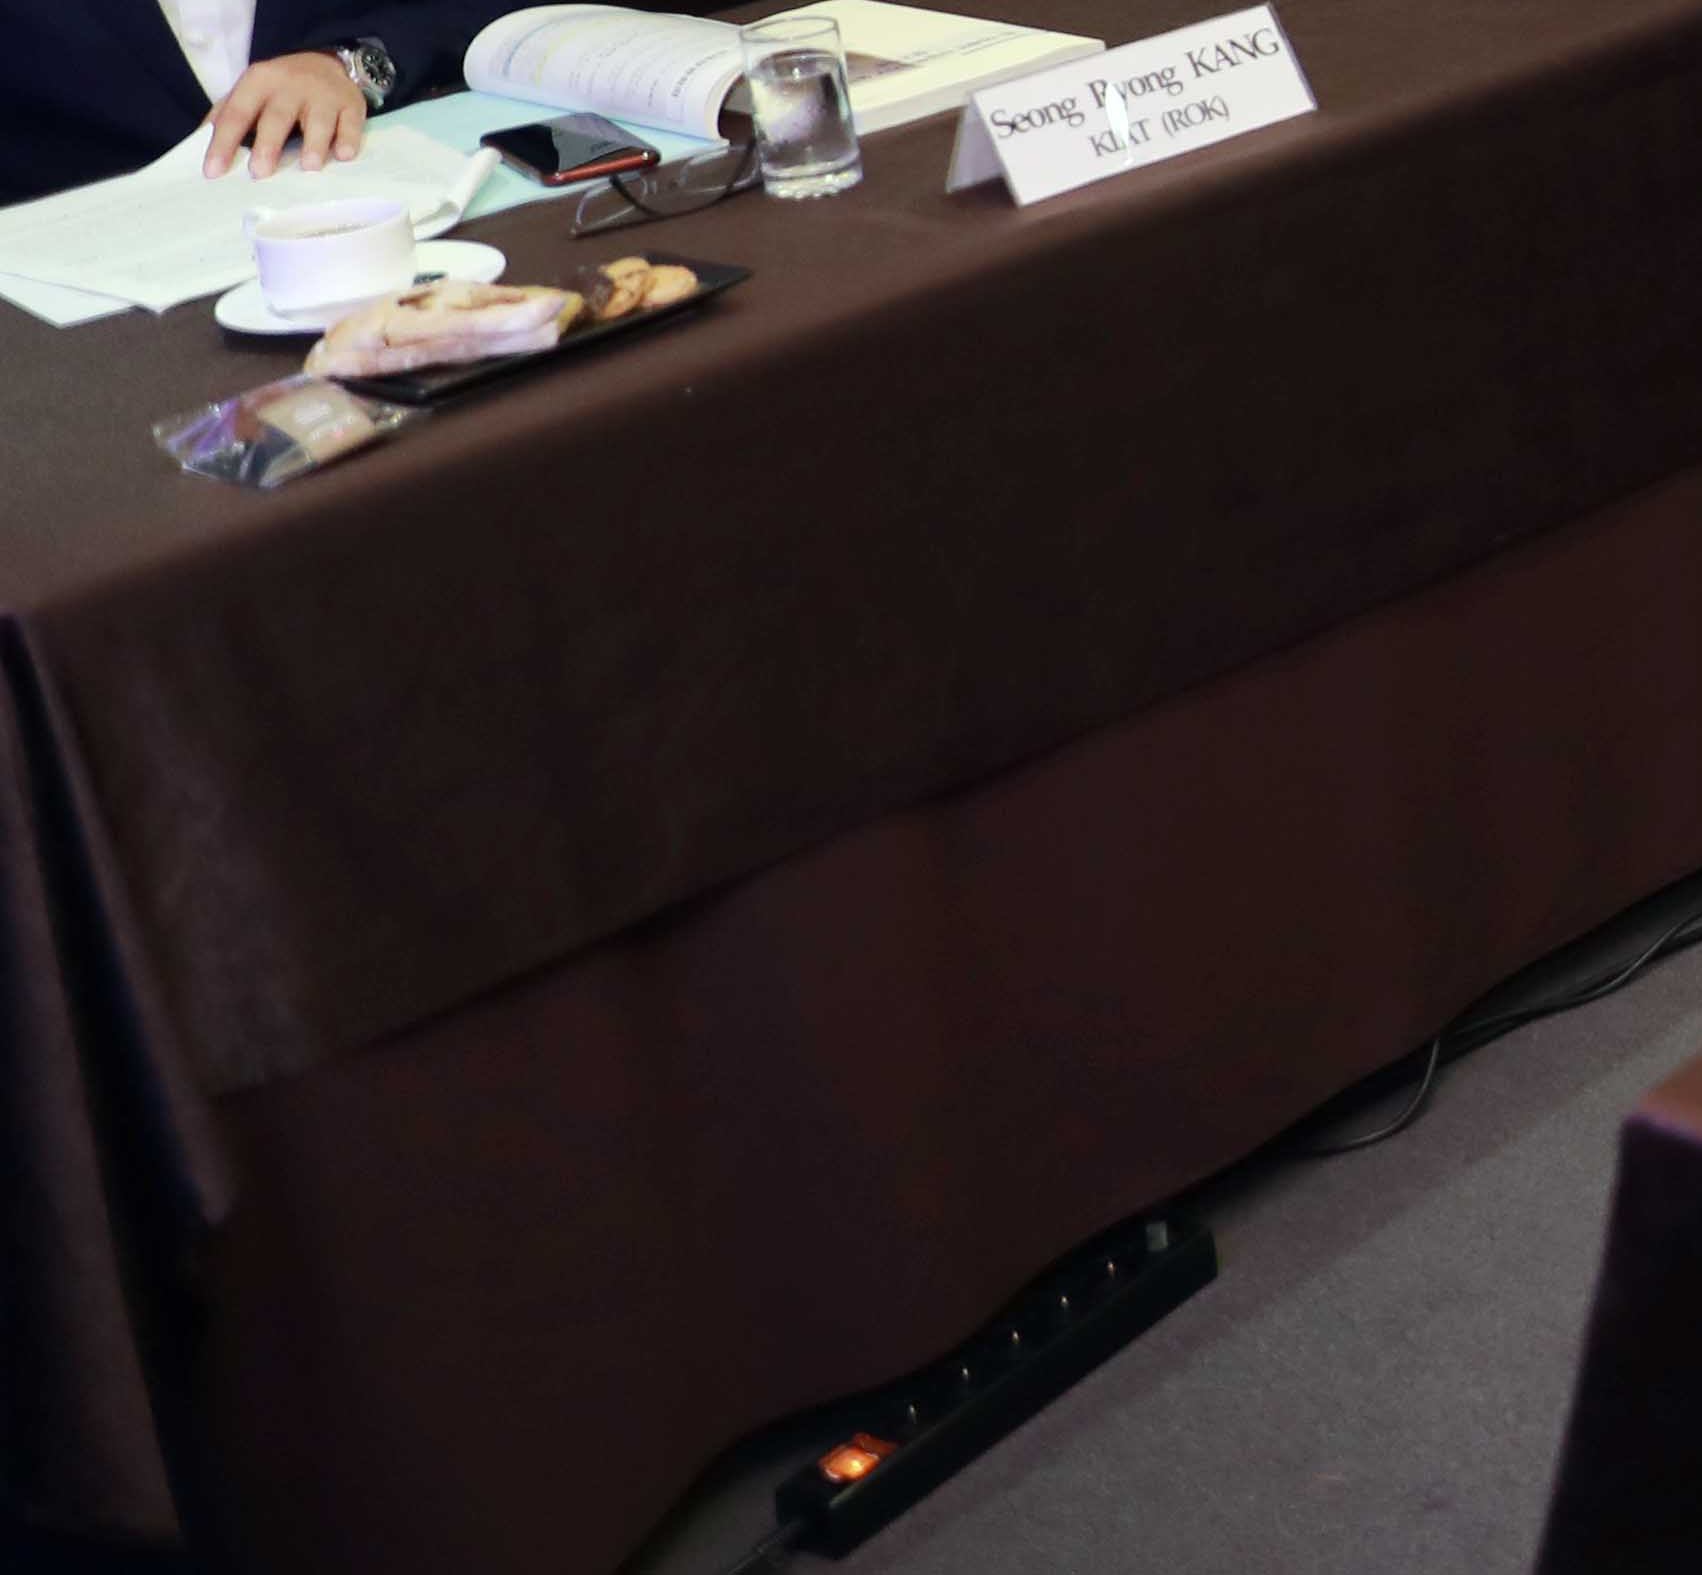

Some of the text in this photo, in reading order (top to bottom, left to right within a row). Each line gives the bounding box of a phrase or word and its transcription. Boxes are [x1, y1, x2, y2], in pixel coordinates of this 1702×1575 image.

[990, 94, 1086, 141] Seong
[1185, 27, 1281, 80] KANG
[1161, 95, 1231, 139] (ROK)
